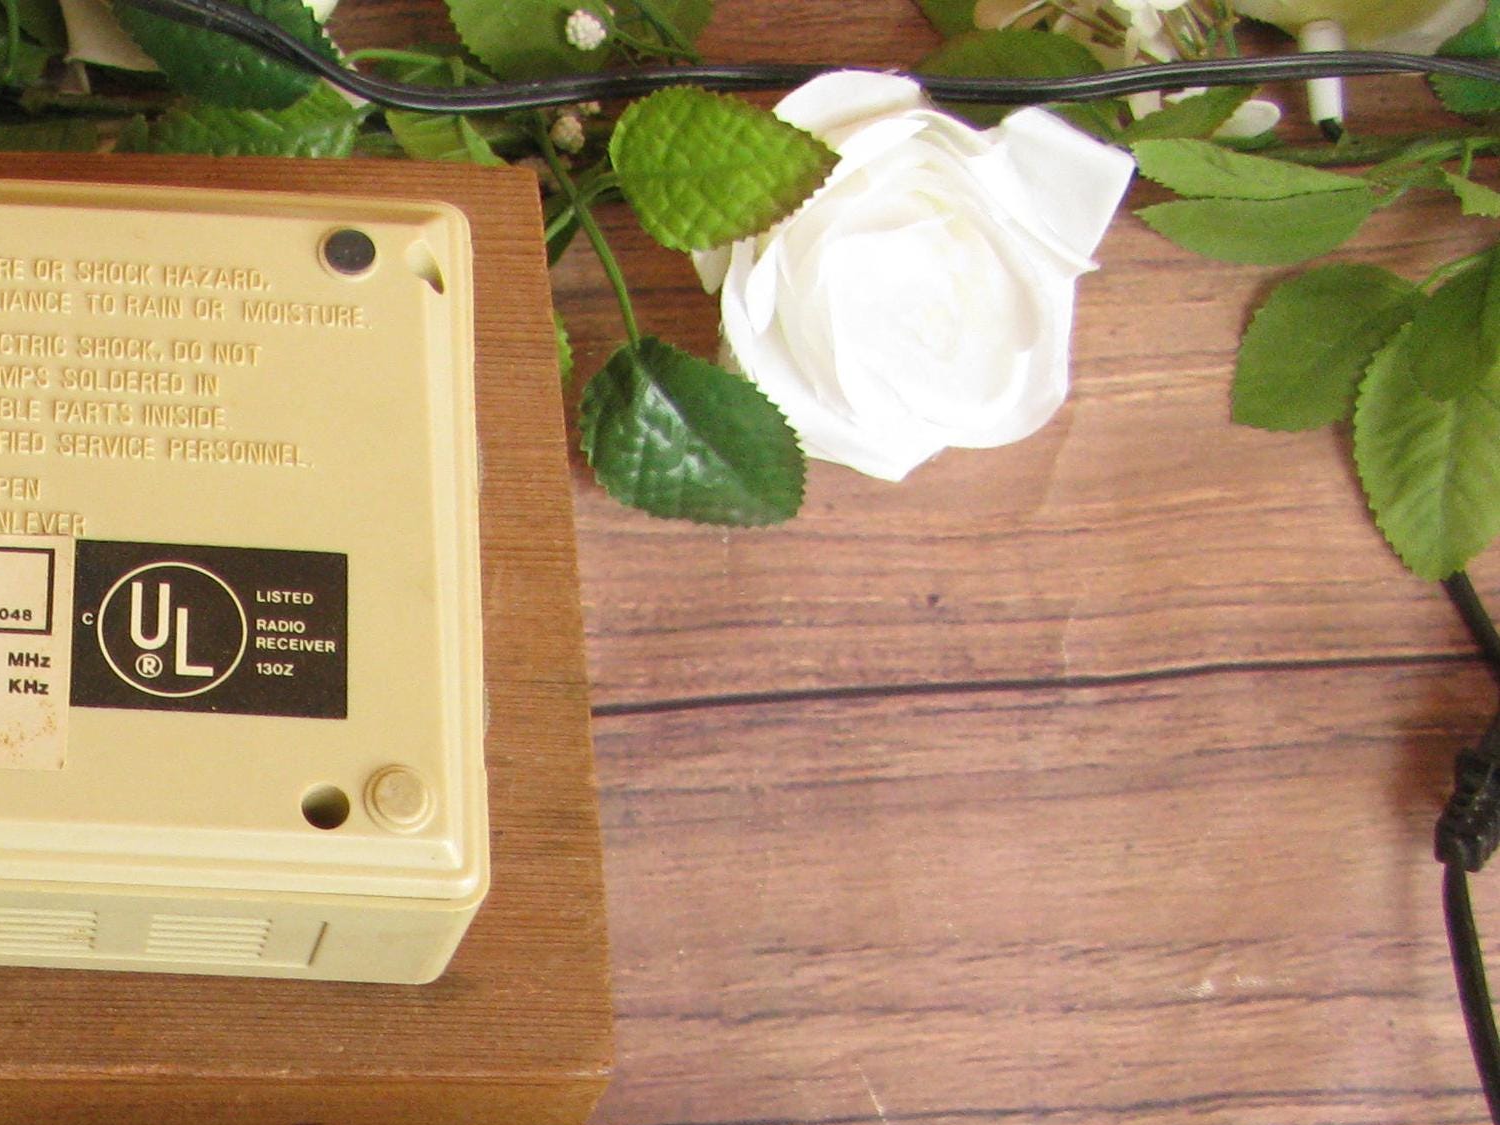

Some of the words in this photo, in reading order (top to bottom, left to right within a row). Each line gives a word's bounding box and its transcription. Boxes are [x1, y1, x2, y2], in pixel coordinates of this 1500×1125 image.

[35, 259, 66, 282] OR
[77, 261, 153, 285] SHOCK
[87, 294, 116, 316] TO
[126, 295, 183, 319] RAIN
[195, 299, 225, 321] OR
[172, 340, 204, 365] DO
[212, 343, 262, 367] NOT
[62, 368, 185, 395] SOLDERED
[195, 374, 220, 397] IN
[53, 401, 134, 425] PARTS
[59, 433, 156, 460] SERVICE
[255, 590, 314, 605] LISTED
[256, 618, 305, 634] RADIO
[255, 637, 336, 653] RECEIVER
[7, 652, 51, 669] MHz
[255, 663, 294, 677] 130Z
[8, 678, 50, 696] KHz
